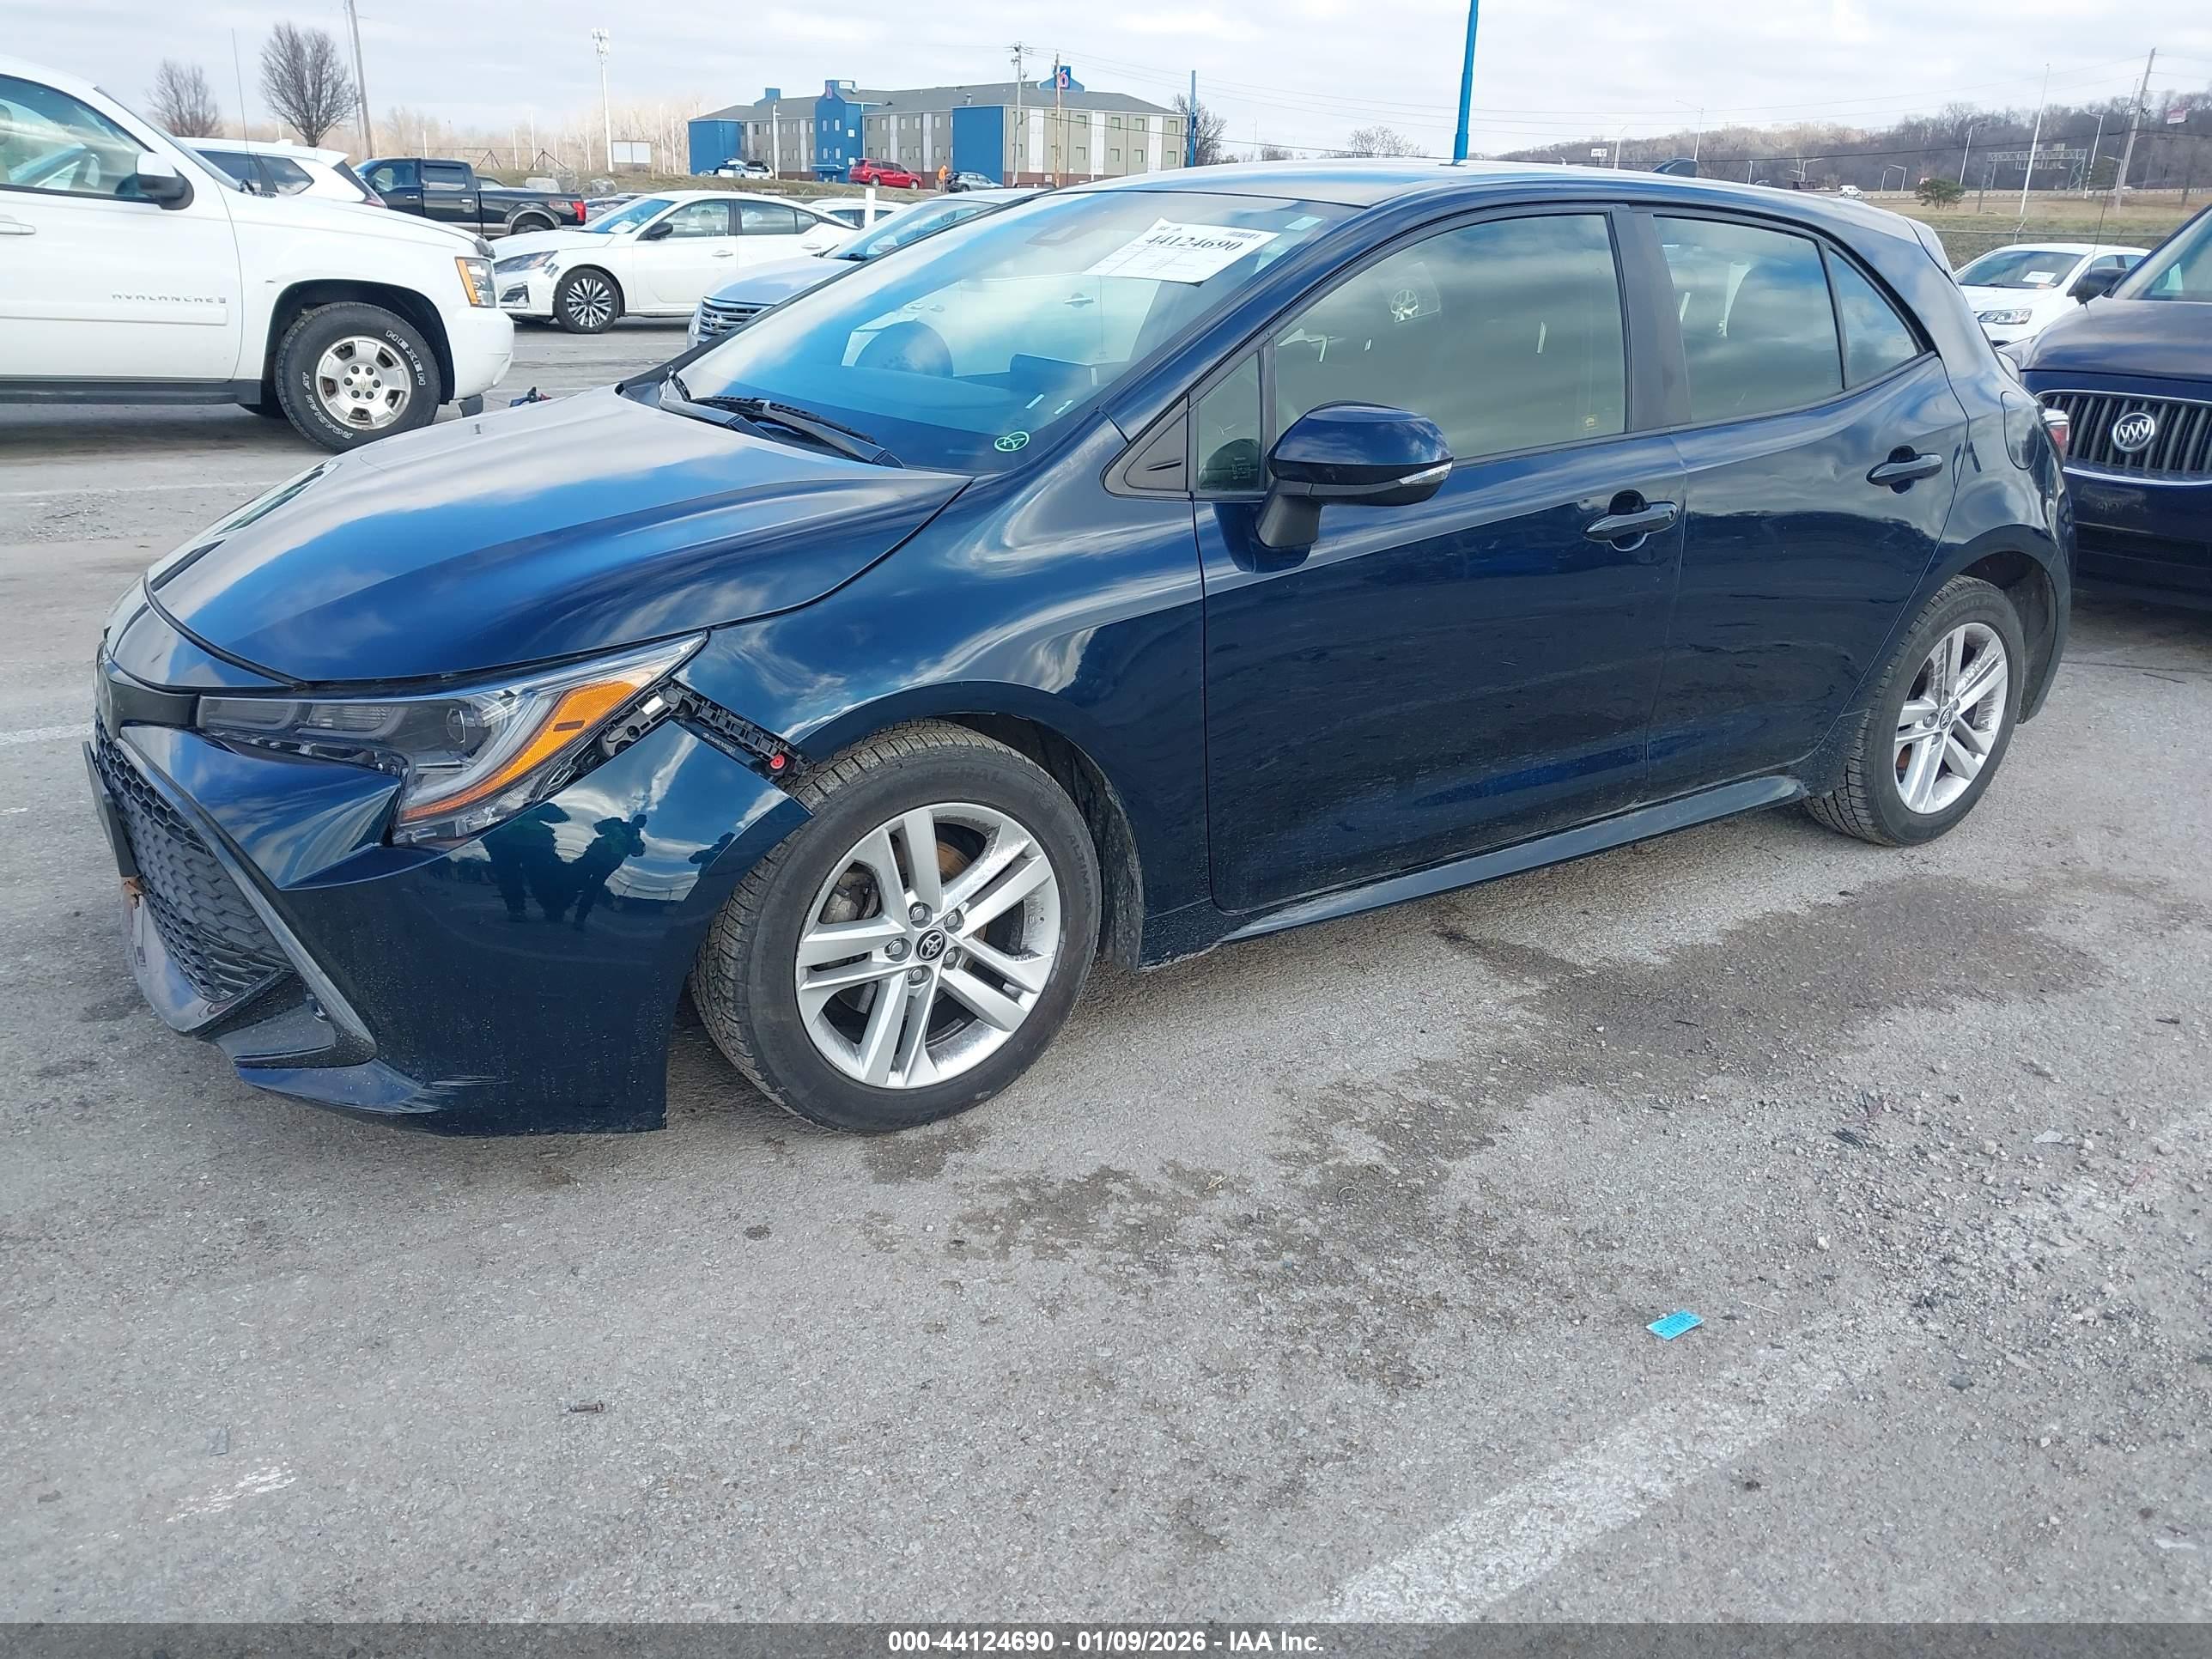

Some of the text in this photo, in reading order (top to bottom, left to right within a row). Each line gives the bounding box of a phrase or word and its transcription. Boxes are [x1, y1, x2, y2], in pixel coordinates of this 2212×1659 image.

[1058, 69, 1069, 88] 6
[1145, 235, 1243, 252] 44124690
[386, 329, 426, 386] NEXEN
[305, 394, 354, 440] ROADIAN
